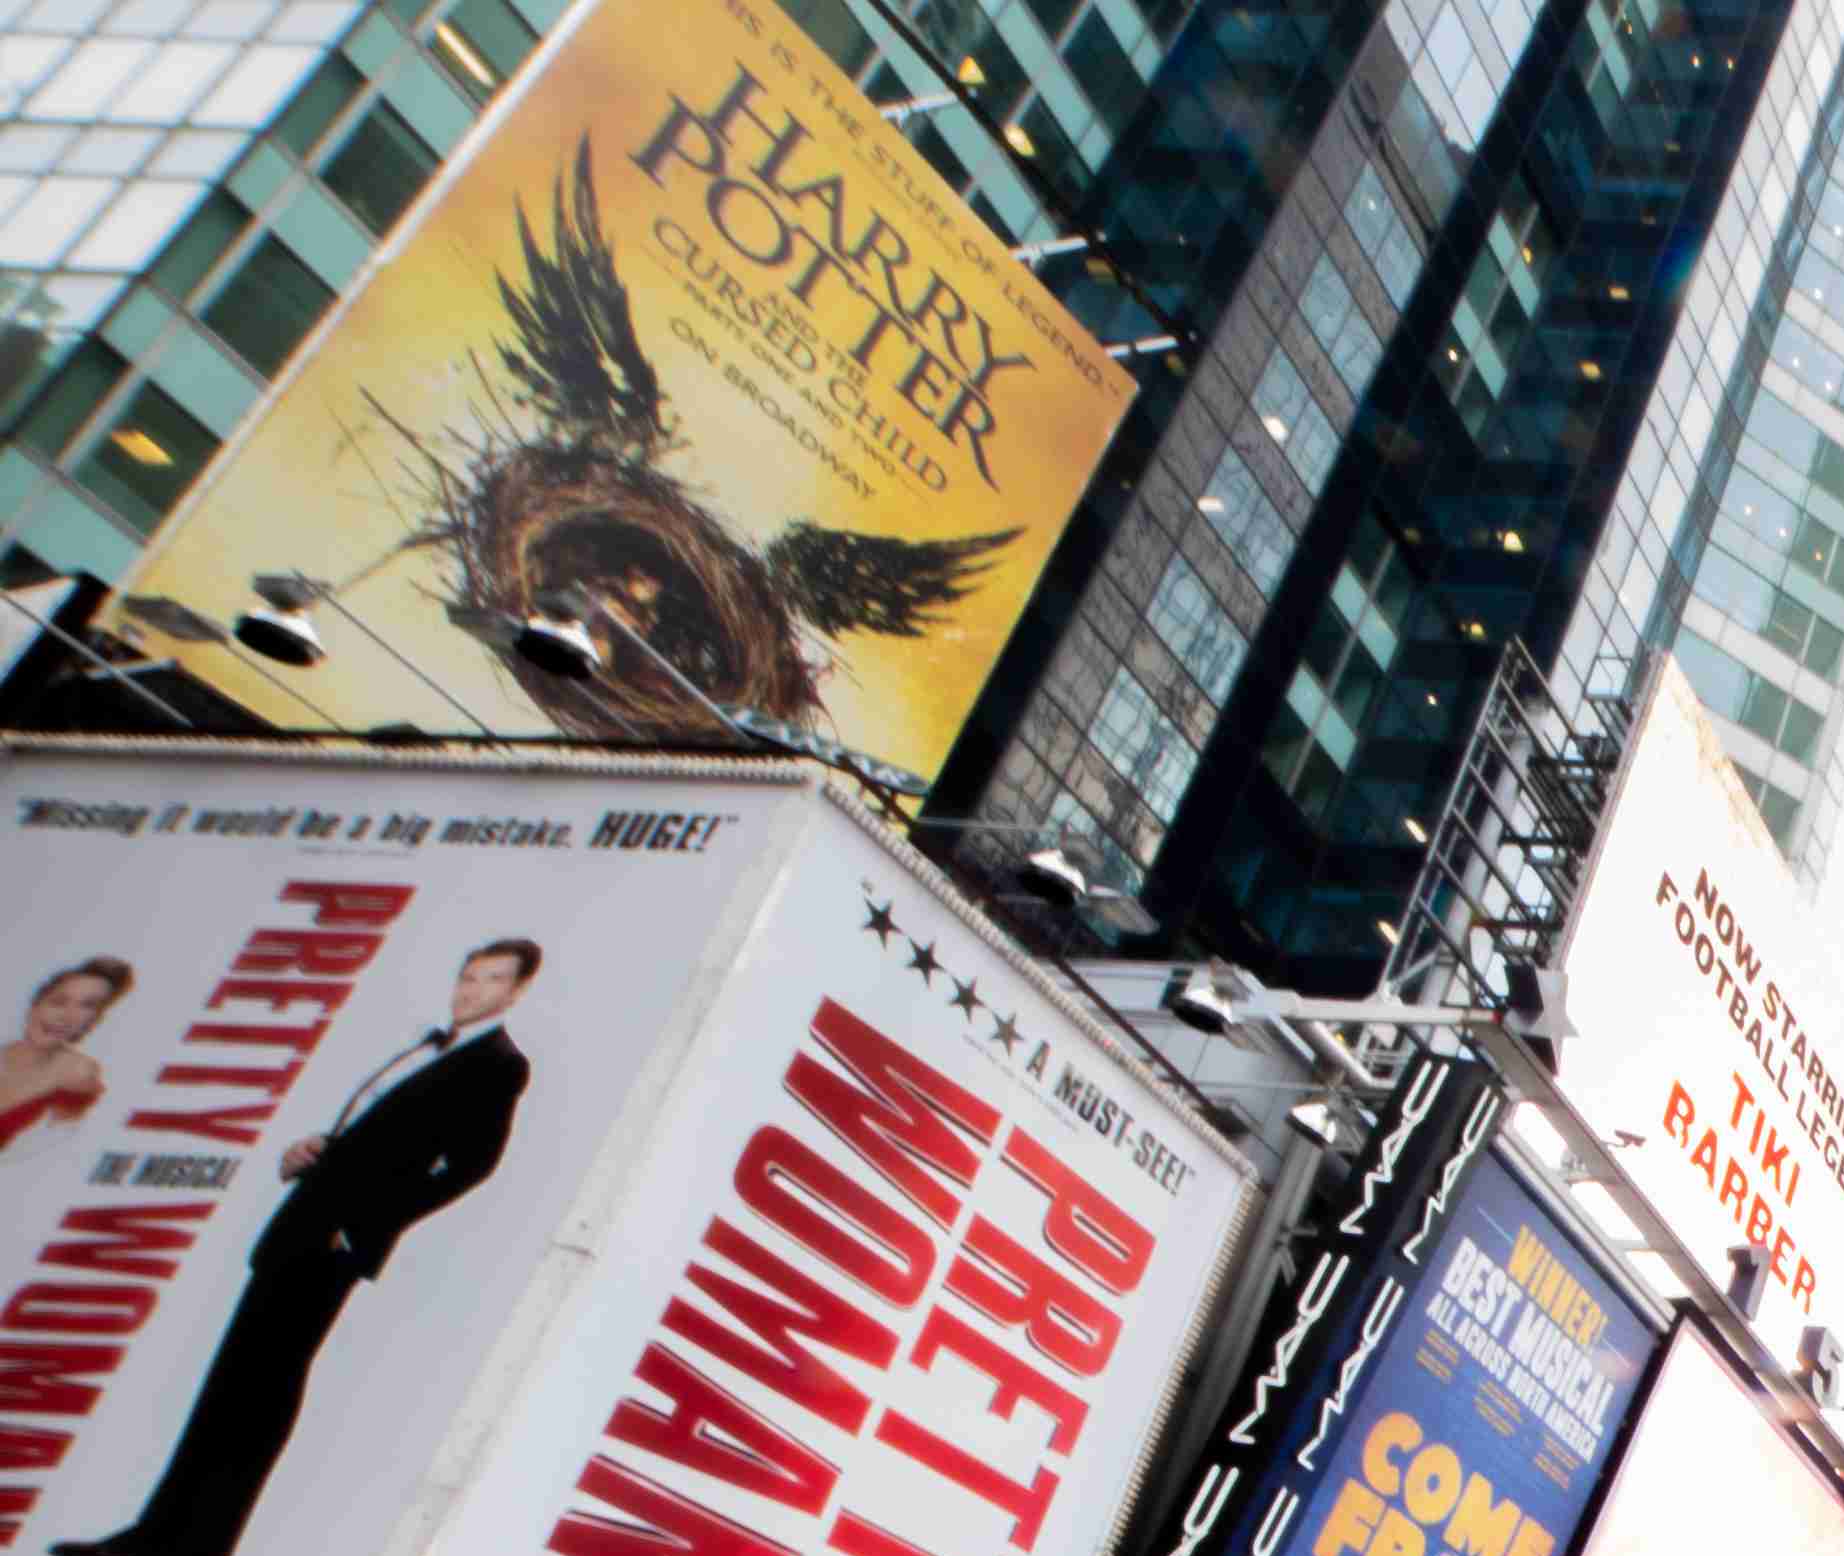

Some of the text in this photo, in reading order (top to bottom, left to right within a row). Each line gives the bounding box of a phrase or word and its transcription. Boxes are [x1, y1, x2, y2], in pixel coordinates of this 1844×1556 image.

[808, 72, 866, 140] THE
[625, 88, 1000, 495] POTTER
[703, 56, 1038, 395] HARRY
[654, 217, 948, 491] CURSED CHILD
[668, 316, 877, 500] ON BROADWAY
[296, 808, 342, 840] be
[347, 814, 373, 841] a
[380, 811, 433, 847] big
[124, 878, 418, 1147] PRETTY
[1654, 870, 1790, 1100] FOOTBALL
[1693, 866, 1762, 984] NOW
[1026, 1040, 1052, 1084] A
[1731, 1071, 1802, 1208] TIKI
[1662, 1078, 1820, 1318] BARBER
[1424, 1290, 1459, 1335] ALL
[1441, 1235, 1524, 1341] BEST
[1508, 1299, 1616, 1439] MUSICAL
